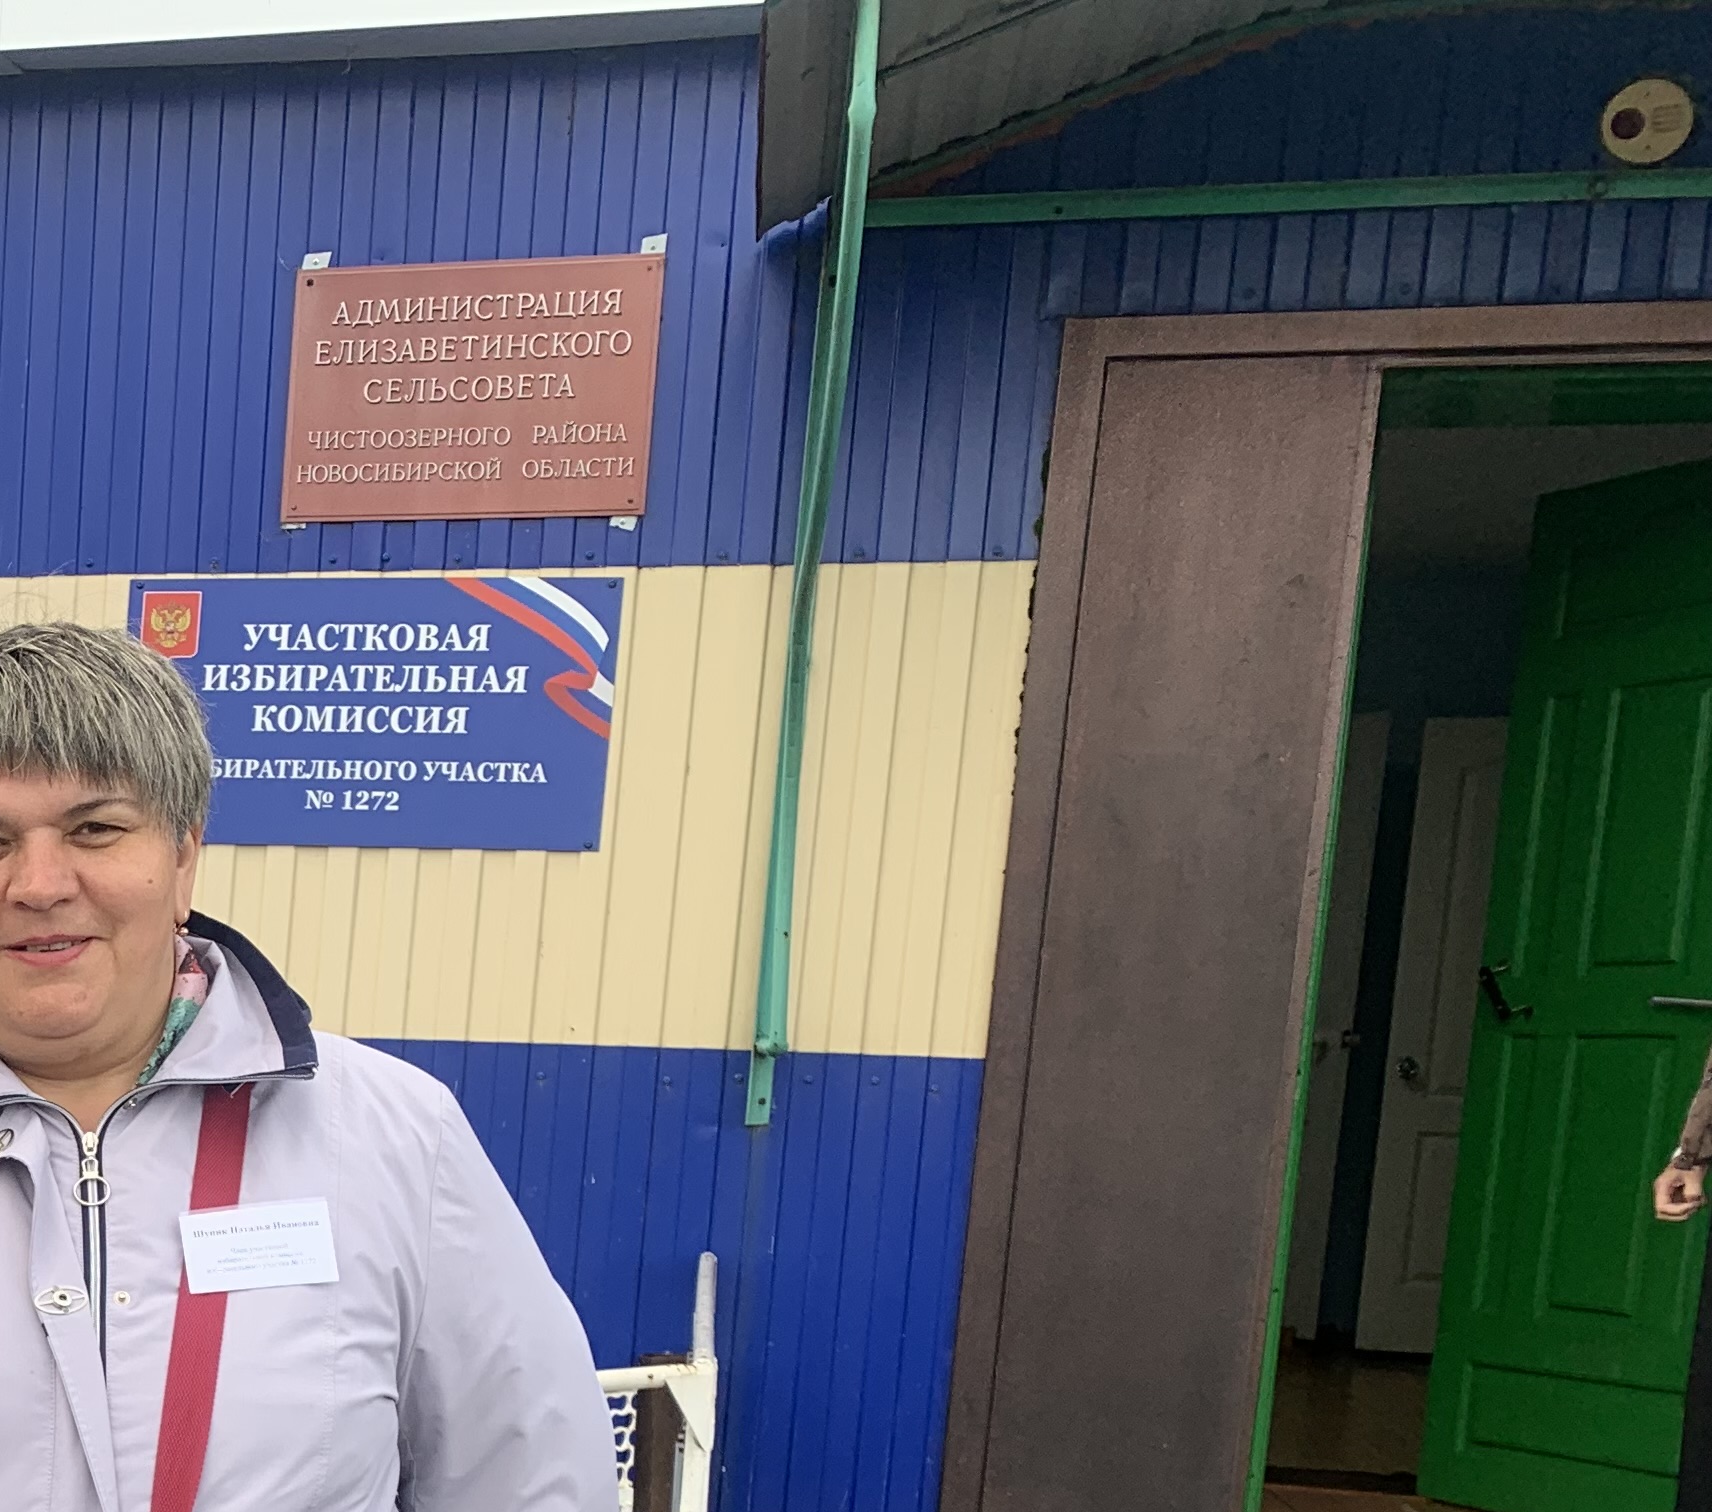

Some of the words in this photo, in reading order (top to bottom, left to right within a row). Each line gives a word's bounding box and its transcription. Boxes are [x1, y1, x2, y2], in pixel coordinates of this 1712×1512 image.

[331, 288, 624, 328] АДМИНИСТРАЦИЯ
[314, 329, 633, 366] ЕЛИЗАВЕТИНСКОГО
[363, 373, 576, 404] СЕЛЬСОВЕТА
[307, 426, 512, 450] ЧИСТООЗЕРНОГО
[531, 420, 628, 445] РАЙОНА
[296, 457, 502, 484] НОВОСИБИРСКОЙ
[522, 456, 635, 480] ОБЛАСТИ
[243, 623, 492, 653] УЧАСТКОВАЯ
[201, 664, 530, 694] ИЗБИРАТЕЛЬНАЯ
[250, 704, 470, 734] КОМИССИЯ
[210, 758, 418, 782] БИРАТЕЛЬНОГО
[422, 761, 548, 784] УЧАСТКА
[304, 790, 335, 811] №
[341, 790, 400, 812] 1272
